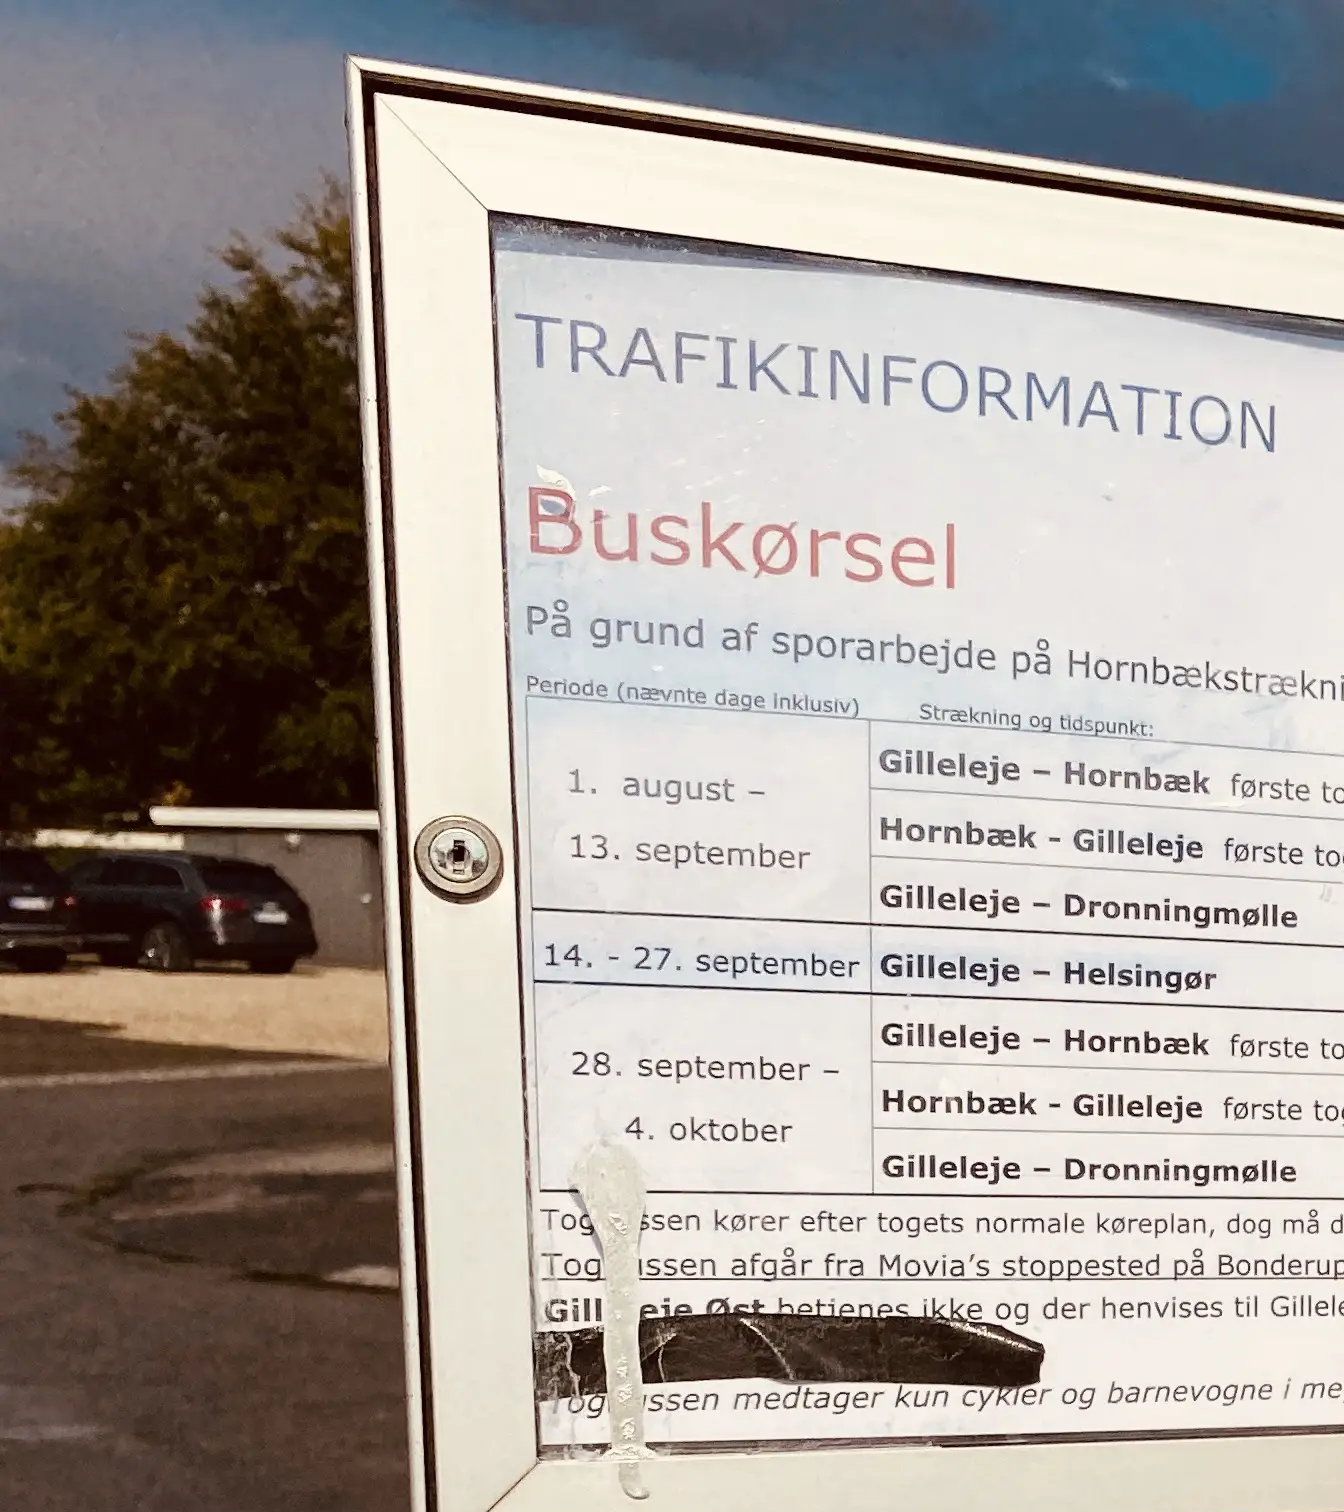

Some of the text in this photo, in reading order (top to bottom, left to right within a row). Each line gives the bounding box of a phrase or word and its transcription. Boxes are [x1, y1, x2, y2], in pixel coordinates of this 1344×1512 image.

[515, 313, 1278, 454] TRAFIKINFORMATION
[527, 484, 959, 590] Buskørsel
[526, 599, 573, 639] På
[589, 612, 704, 651] grund
[721, 620, 759, 654] af
[772, 628, 998, 677] sporarbejde
[1011, 640, 1053, 679] på
[526, 675, 859, 718] Periode (nævnte dage inklusiv)
[920, 704, 1153, 737] Strækning og tidspunkt:
[569, 769, 596, 794] 1.
[622, 776, 735, 805] august
[879, 749, 1020, 786] Gilleleje
[1064, 761, 1210, 796] Hornbæk
[1231, 773, 1310, 801] første
[570, 834, 811, 869] 13. september
[880, 817, 1036, 849] Hornbæk
[1073, 828, 1203, 863] Gilleleje
[1224, 837, 1303, 865] første
[880, 884, 1020, 919] Gilleleje
[1064, 893, 1298, 929] Dronningmølle
[545, 943, 592, 968] 14.
[634, 947, 682, 971] 27.
[696, 952, 860, 979] september
[880, 954, 1021, 987] Gilleleje
[1064, 961, 1217, 994] Helsingør
[881, 1023, 1020, 1055] Gilleleje
[1064, 1029, 1209, 1056] Hornbæk
[1230, 1034, 1308, 1058] første
[572, 1051, 622, 1077] 28.
[638, 1056, 810, 1083] september
[882, 1090, 1036, 1116] Hornbæk
[1073, 1094, 1203, 1123] Gilleleje
[1223, 1097, 1302, 1122] første
[625, 1116, 793, 1142] 4. oktober
[882, 1155, 1021, 1185] Gilleleje
[1064, 1158, 1297, 1186] Dronningmølle
[540, 1209, 700, 1236] Togssen
[714, 1209, 790, 1232] kører
[800, 1210, 867, 1233] efter
[878, 1212, 963, 1238] togets
[976, 1213, 1085, 1234] normale
[1097, 1214, 1215, 1238] køreplan,
[1227, 1213, 1271, 1238] dog
[1283, 1209, 1319, 1235] må
[732, 1247, 816, 1281] afgår
[825, 1254, 864, 1276] fra
[1003, 1254, 1160, 1280] stoppested
[1174, 1249, 1204, 1279] på
[545, 1299, 692, 1325] Gilleje
[923, 1298, 982, 1319] ikke
[995, 1301, 1029, 1324] og
[1043, 1297, 1090, 1319] der
[1102, 1297, 1223, 1318] henvises
[1235, 1296, 1263, 1317] til
[734, 1387, 884, 1414] medtager
[896, 1386, 949, 1407] kun
[962, 1386, 1052, 1411] cykler
[1061, 1387, 1096, 1409] og
[1109, 1381, 1272, 1406] barnevogne
